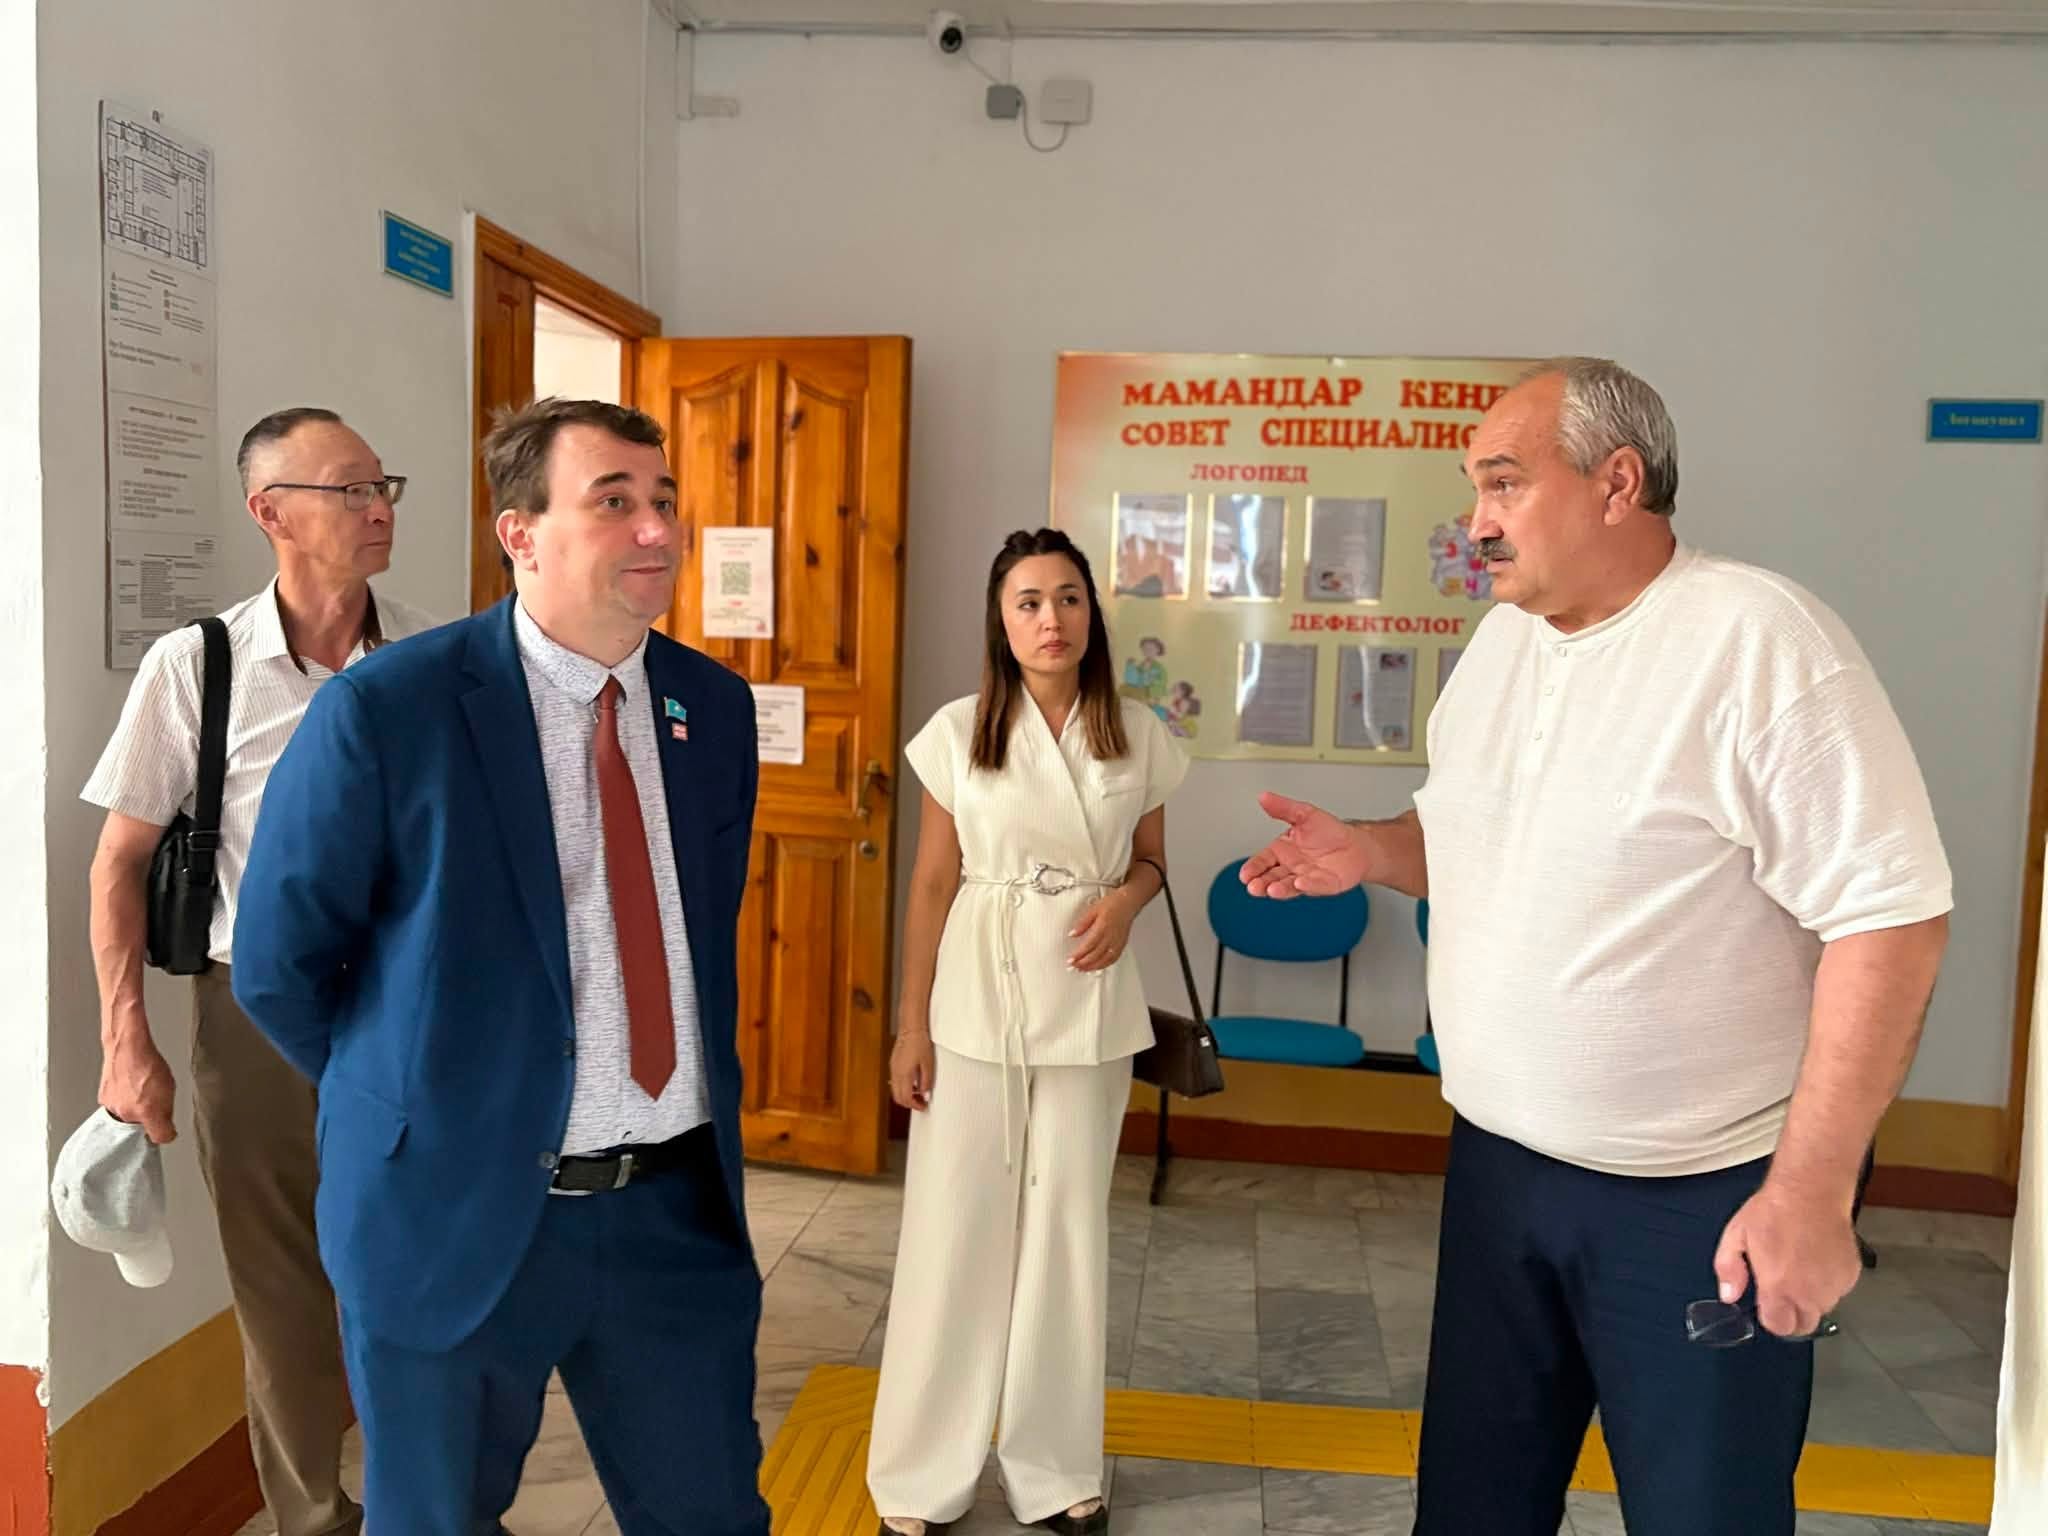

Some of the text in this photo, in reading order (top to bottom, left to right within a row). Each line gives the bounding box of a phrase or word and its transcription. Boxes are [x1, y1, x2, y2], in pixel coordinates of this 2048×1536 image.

[1122, 378, 1363, 410] МАМАНДАР
[1121, 419, 1231, 446] СОВЕТ
[1190, 463, 1309, 484] ЛОГОПЕД
[1290, 613, 1465, 635] ДЕФЕКТОЛОГ
